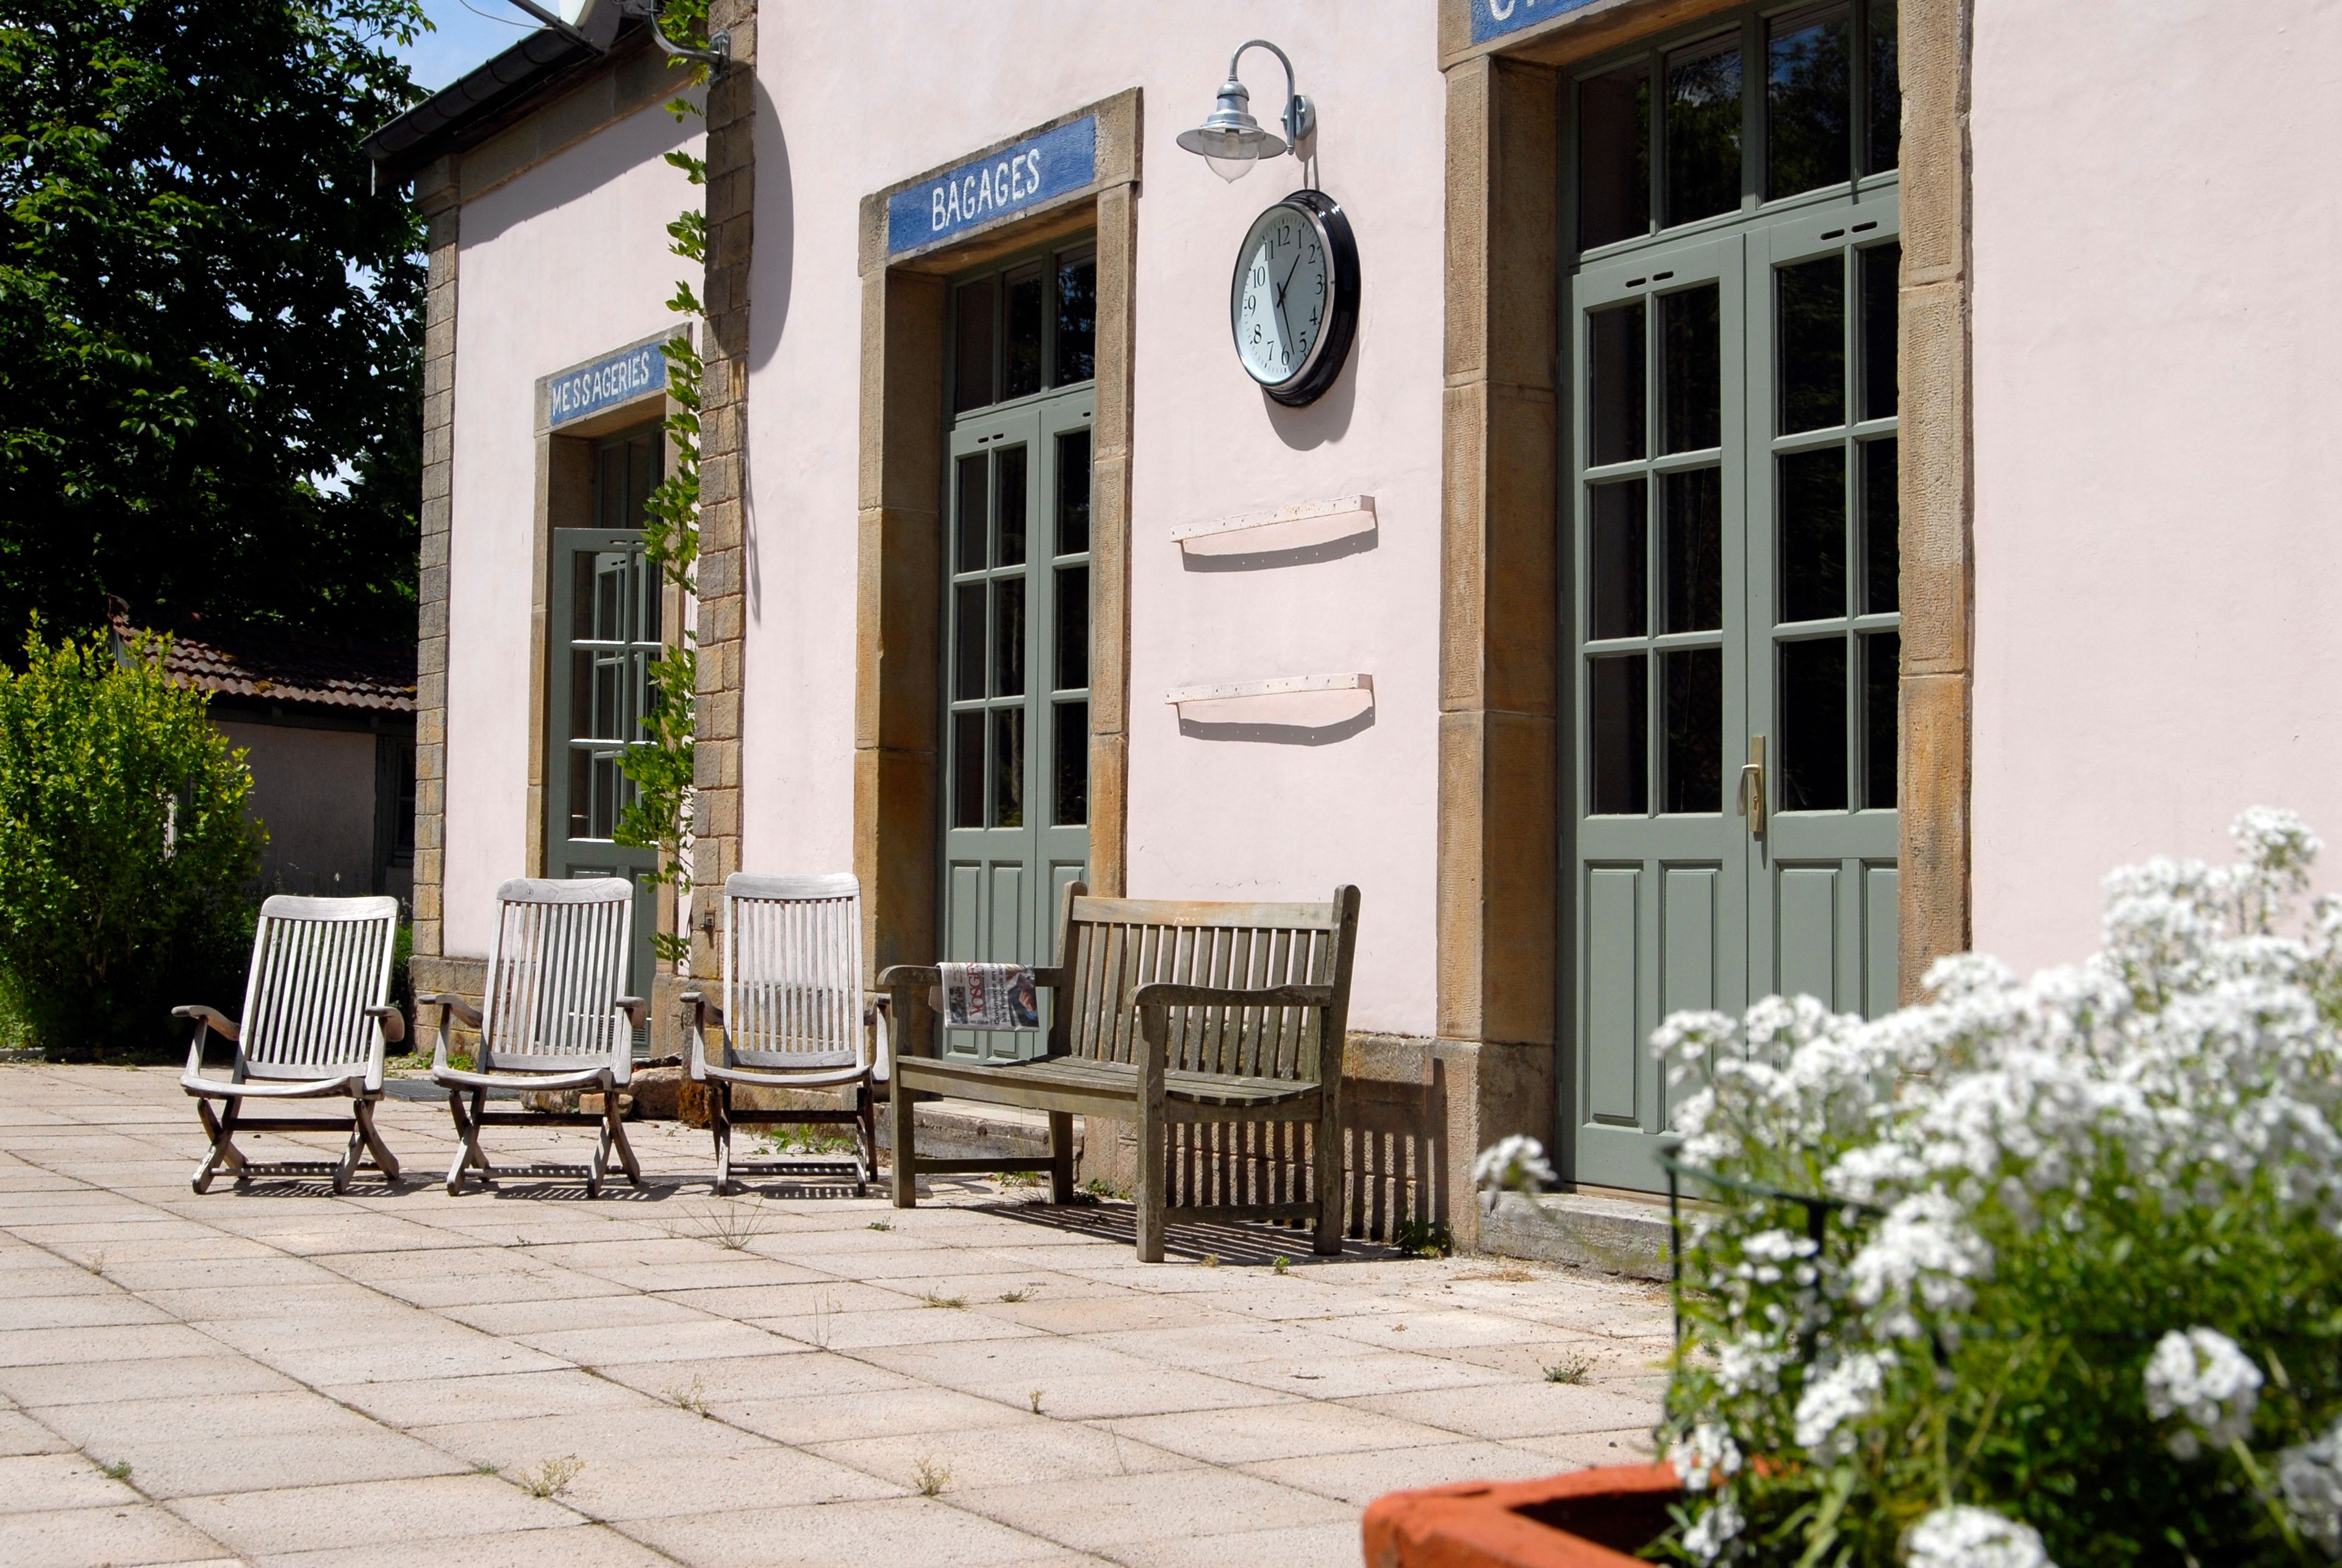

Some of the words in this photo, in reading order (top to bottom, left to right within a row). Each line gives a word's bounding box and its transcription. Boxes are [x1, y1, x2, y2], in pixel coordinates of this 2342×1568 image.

[932, 148, 1040, 232] BAGAGES
[1277, 225, 1290, 246] 12
[1297, 229, 1303, 249] 1
[1263, 240, 1275, 262] 11
[1307, 244, 1316, 265] 2
[1252, 265, 1266, 288] 10
[1315, 274, 1323, 295] 3
[1247, 295, 1256, 317] 9
[1309, 305, 1317, 326] 4
[1253, 323, 1262, 345] 8
[1299, 331, 1307, 353] 5
[1267, 340, 1275, 361] 7
[1281, 345, 1289, 366] 6
[552, 351, 650, 417] MESSAGERIES
